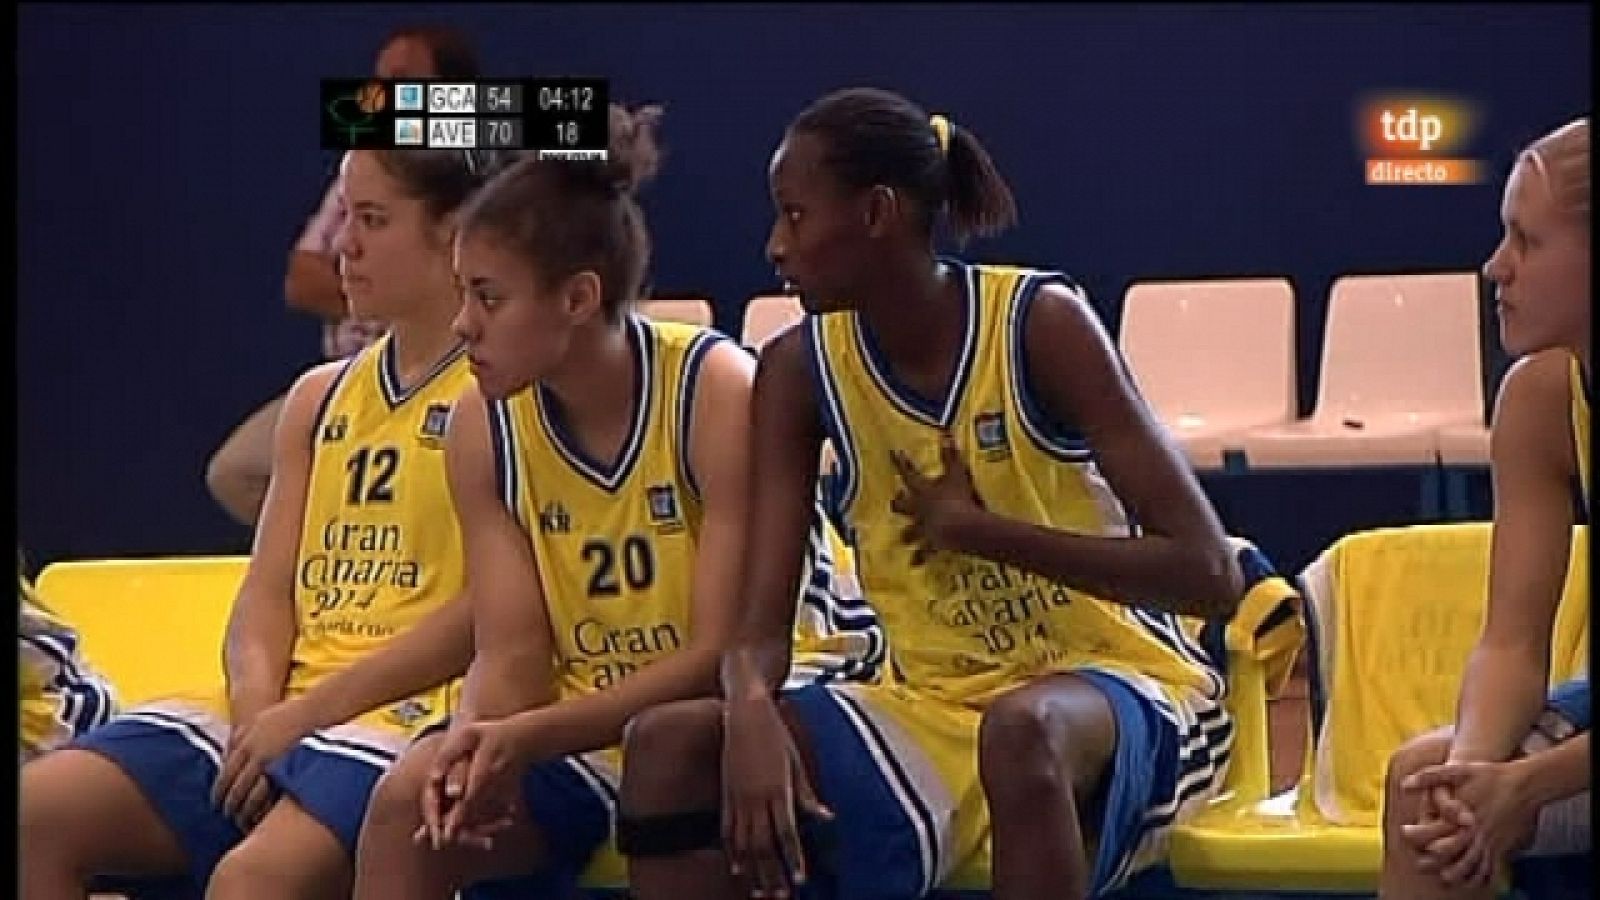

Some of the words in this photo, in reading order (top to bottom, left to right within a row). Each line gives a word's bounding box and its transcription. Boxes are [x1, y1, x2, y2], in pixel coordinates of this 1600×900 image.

[347, 447, 399, 505] 12
[582, 535, 655, 597] 20
[574, 618, 680, 656] Gran
